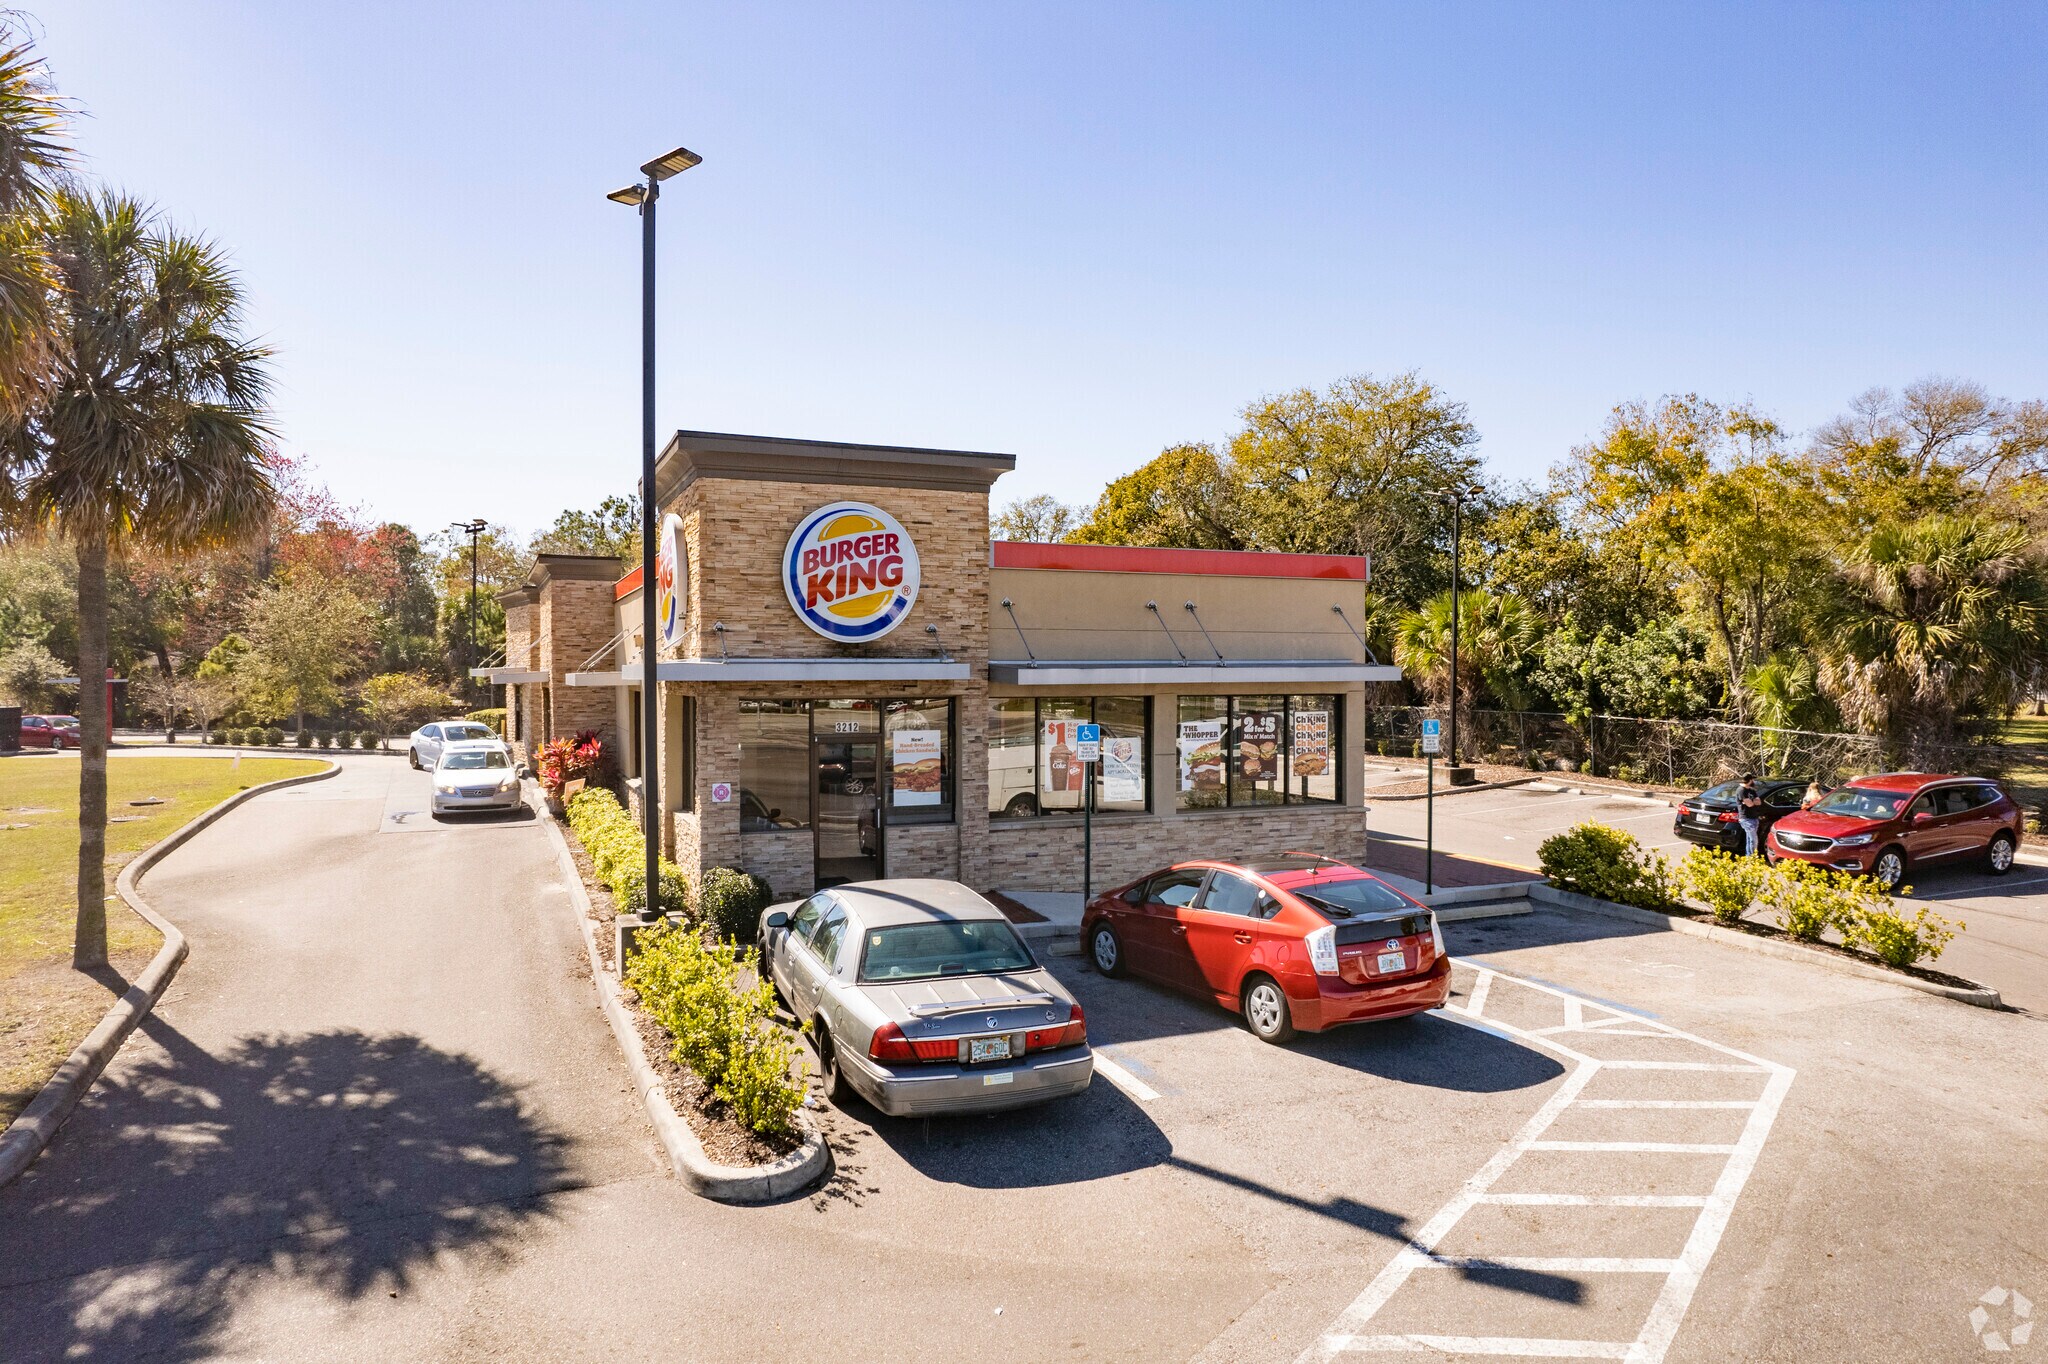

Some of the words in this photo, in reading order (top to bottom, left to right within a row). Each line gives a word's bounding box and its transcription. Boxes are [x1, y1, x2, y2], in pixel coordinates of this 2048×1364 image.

[803, 533, 900, 575] BURGER
[805, 556, 903, 609] KING
[836, 722, 859, 732] 3212
[1048, 722, 1066, 745] $1
[1244, 716, 1254, 732] 2
[1260, 716, 1275, 732] $5
[1183, 731, 1219, 739] WHOPPER
